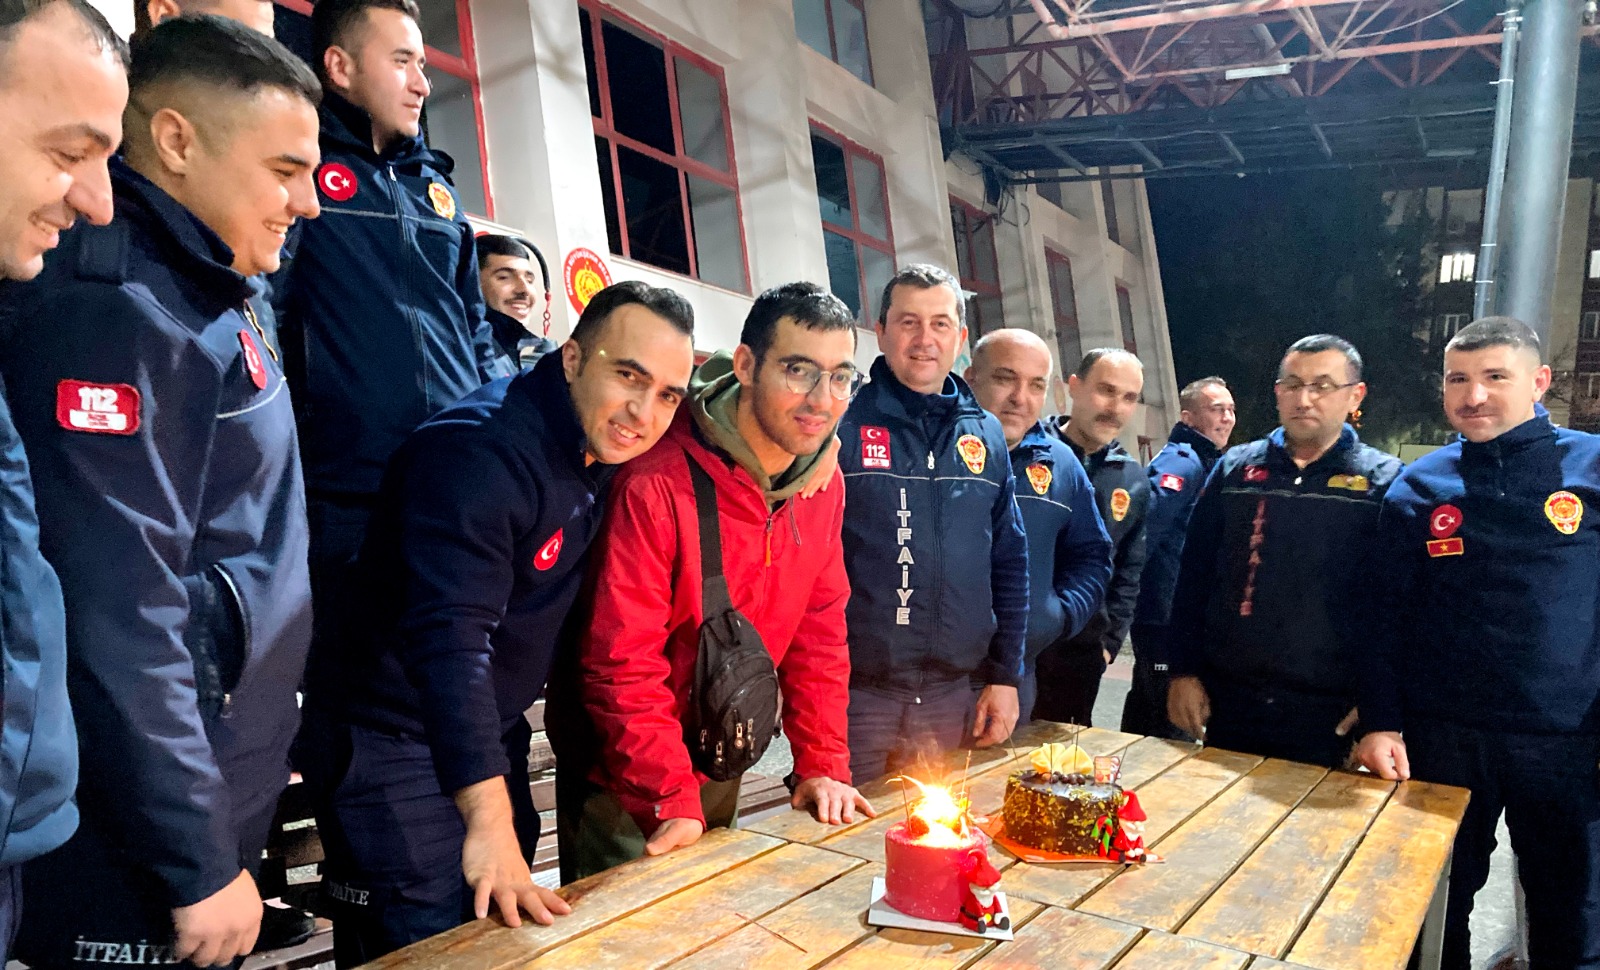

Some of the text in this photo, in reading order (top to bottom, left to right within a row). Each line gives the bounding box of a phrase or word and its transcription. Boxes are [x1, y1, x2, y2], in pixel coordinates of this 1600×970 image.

[78, 386, 119, 412] 112
[865, 443, 887, 458] 112
[896, 487, 915, 625] İTFAİYE
